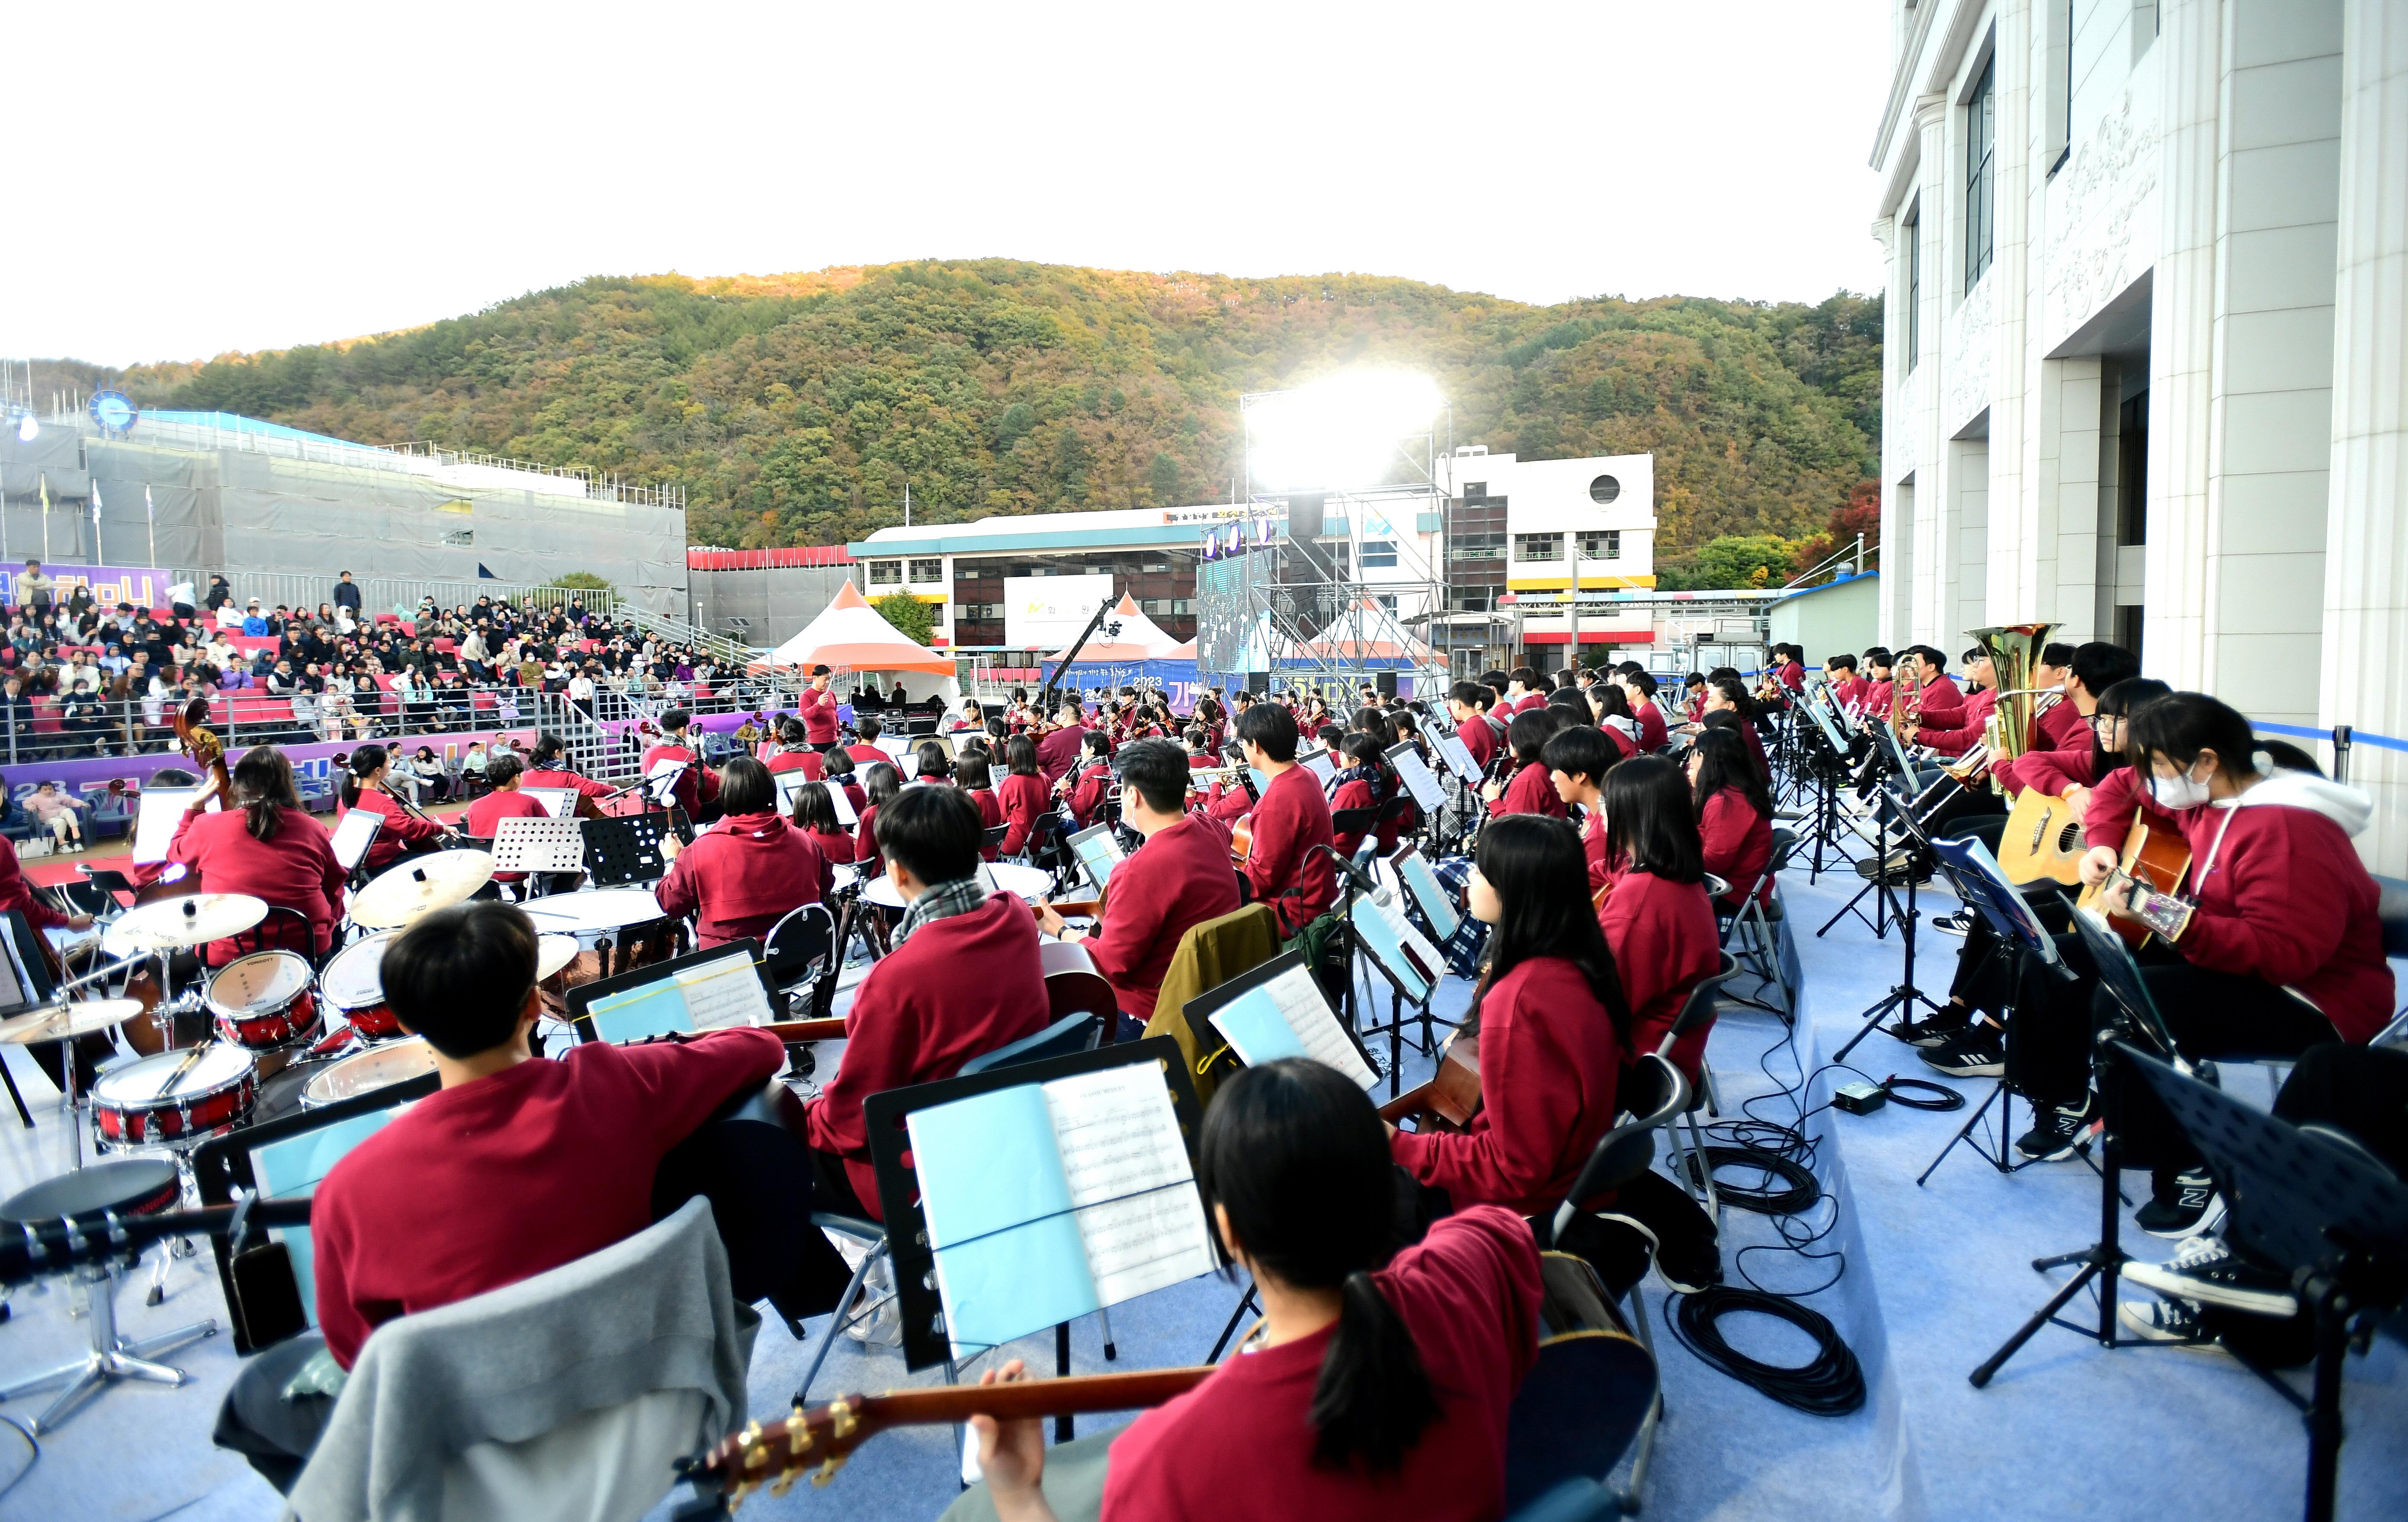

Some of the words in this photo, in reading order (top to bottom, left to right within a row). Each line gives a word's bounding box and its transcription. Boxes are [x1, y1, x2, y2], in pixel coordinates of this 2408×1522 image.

[1133, 676, 1162, 687] 2023
[247, 957, 273, 966] VONGOTT
[245, 998, 267, 1007] EVANS
[1080, 1090, 1102, 1099] CLASSIC
[1103, 1086, 1126, 1094] MEDLEY
